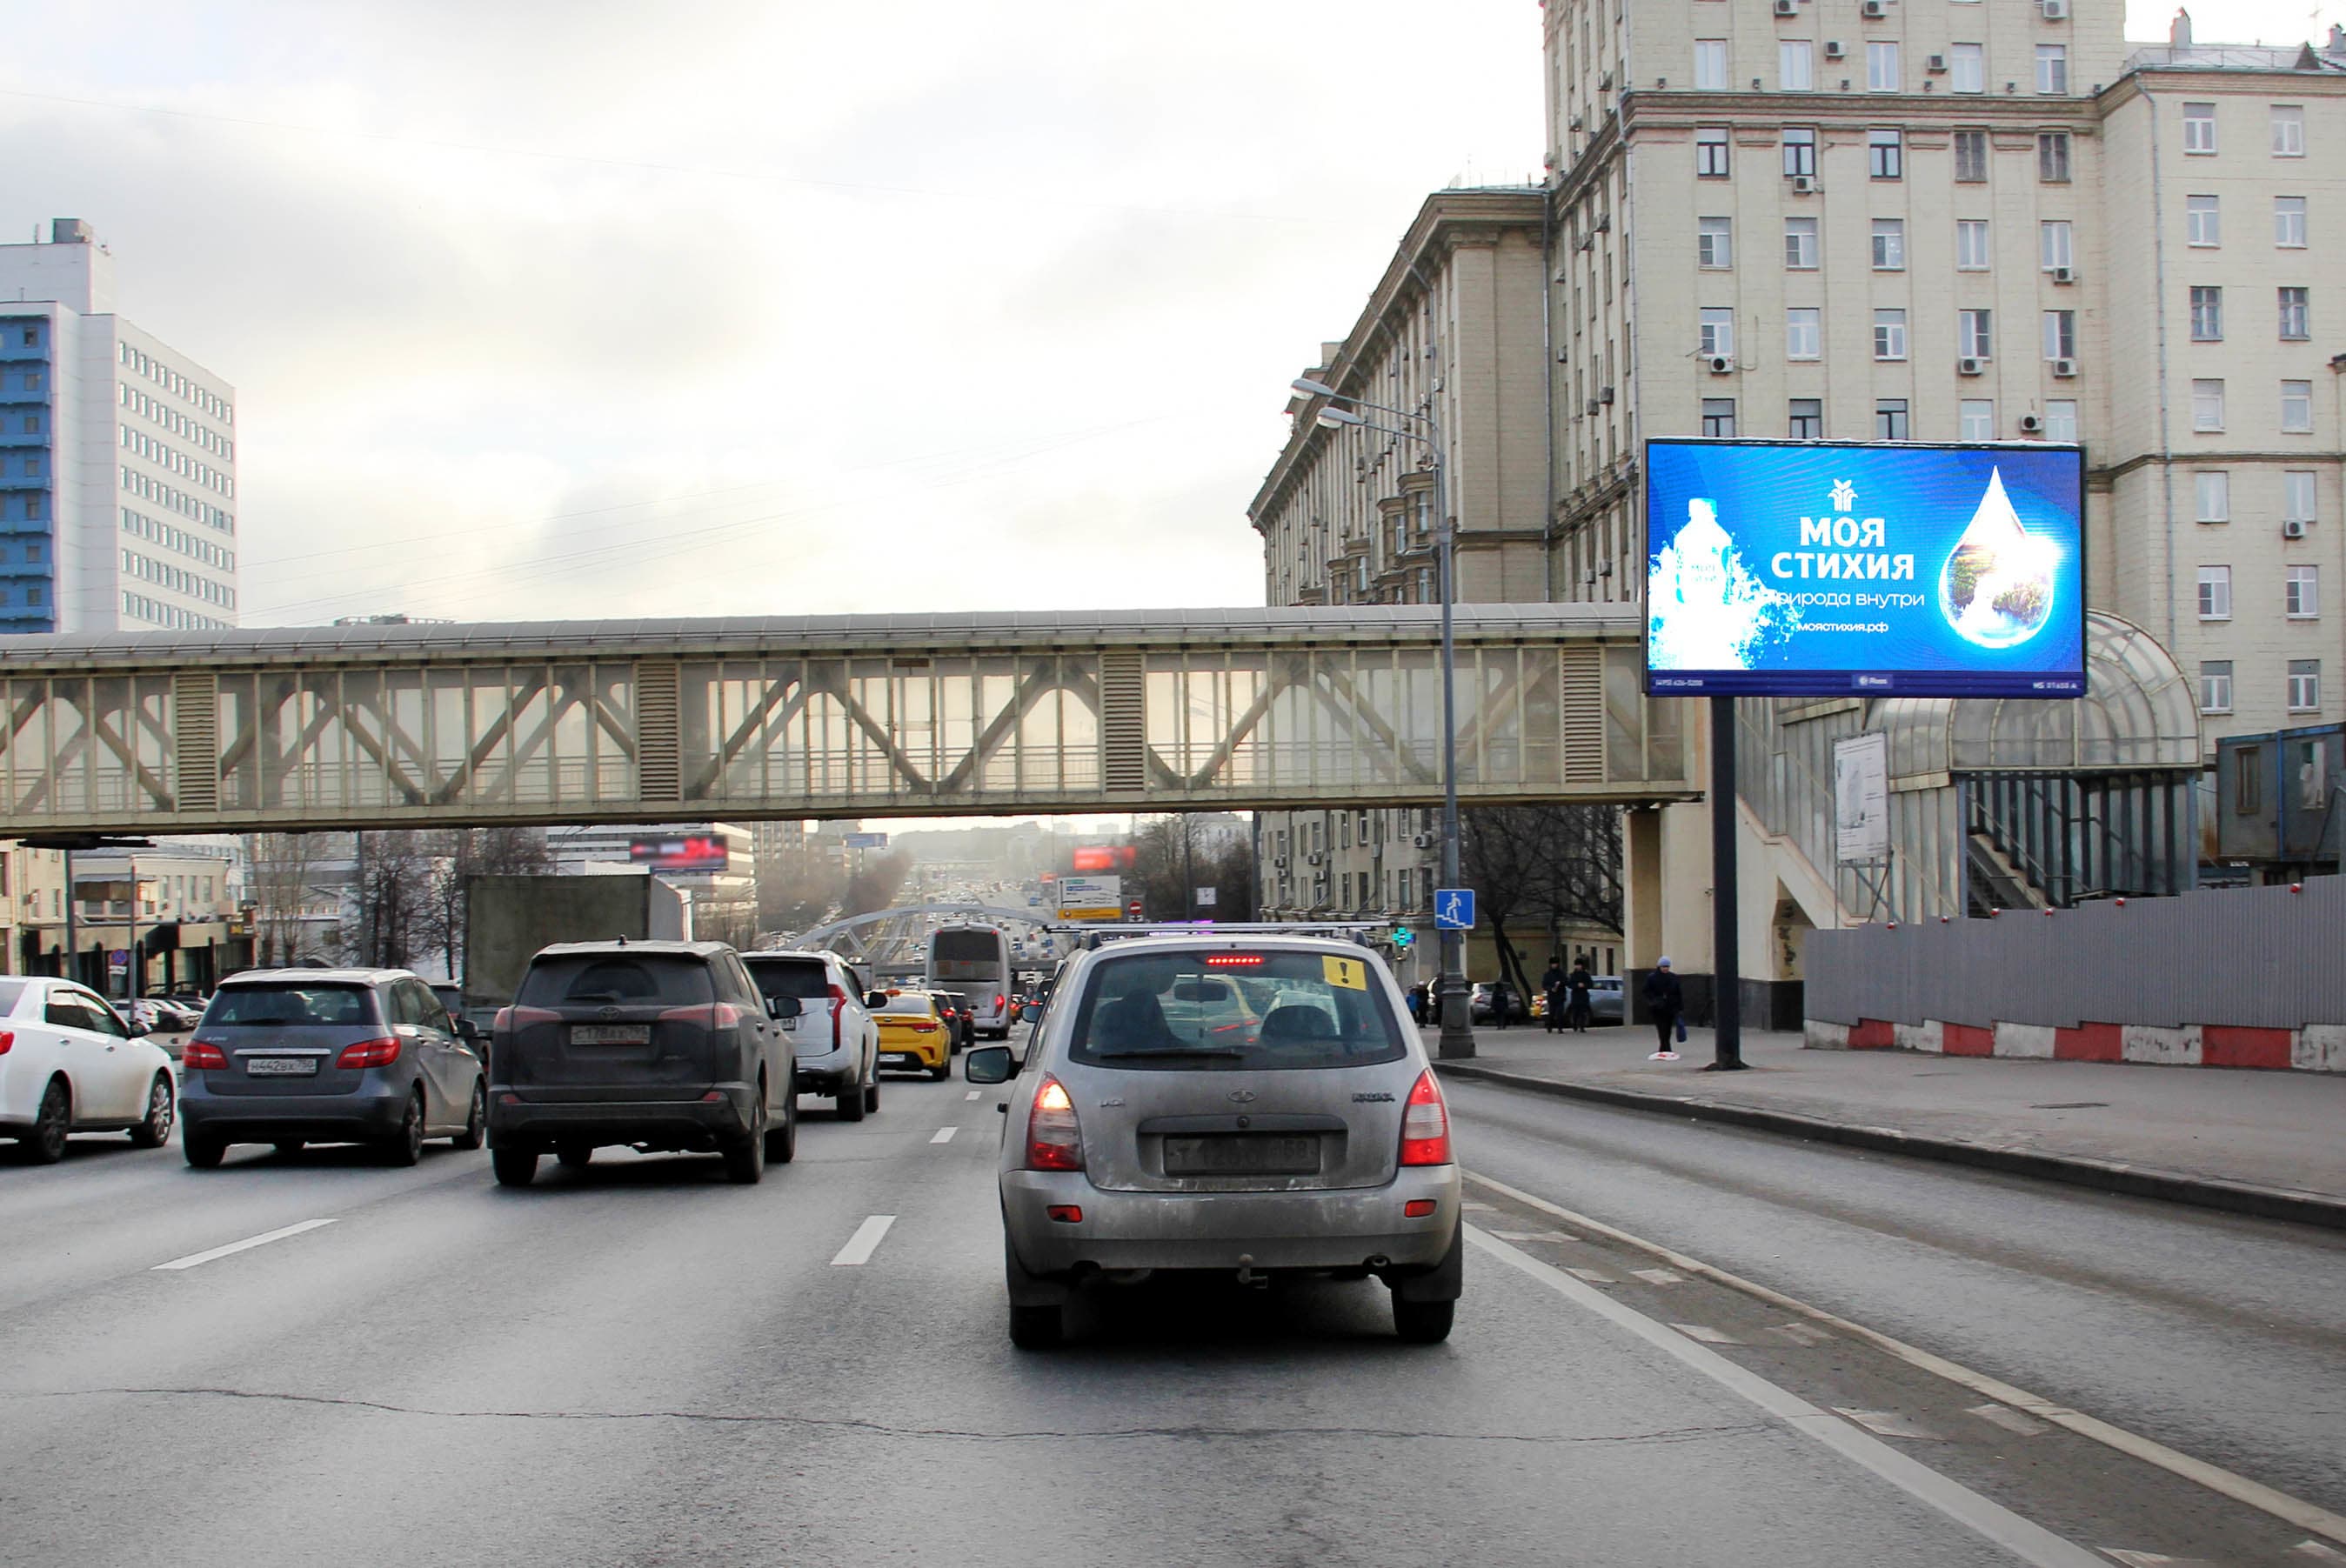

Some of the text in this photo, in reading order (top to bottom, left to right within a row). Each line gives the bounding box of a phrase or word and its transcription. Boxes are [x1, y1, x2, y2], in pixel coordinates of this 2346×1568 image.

[1800, 517, 1885, 547] МОЯ
[1771, 552, 1914, 580] СТИХИЯ
[1763, 592, 1924, 608] рирода внутри
[1797, 622, 1888, 633] моястихия.рф
